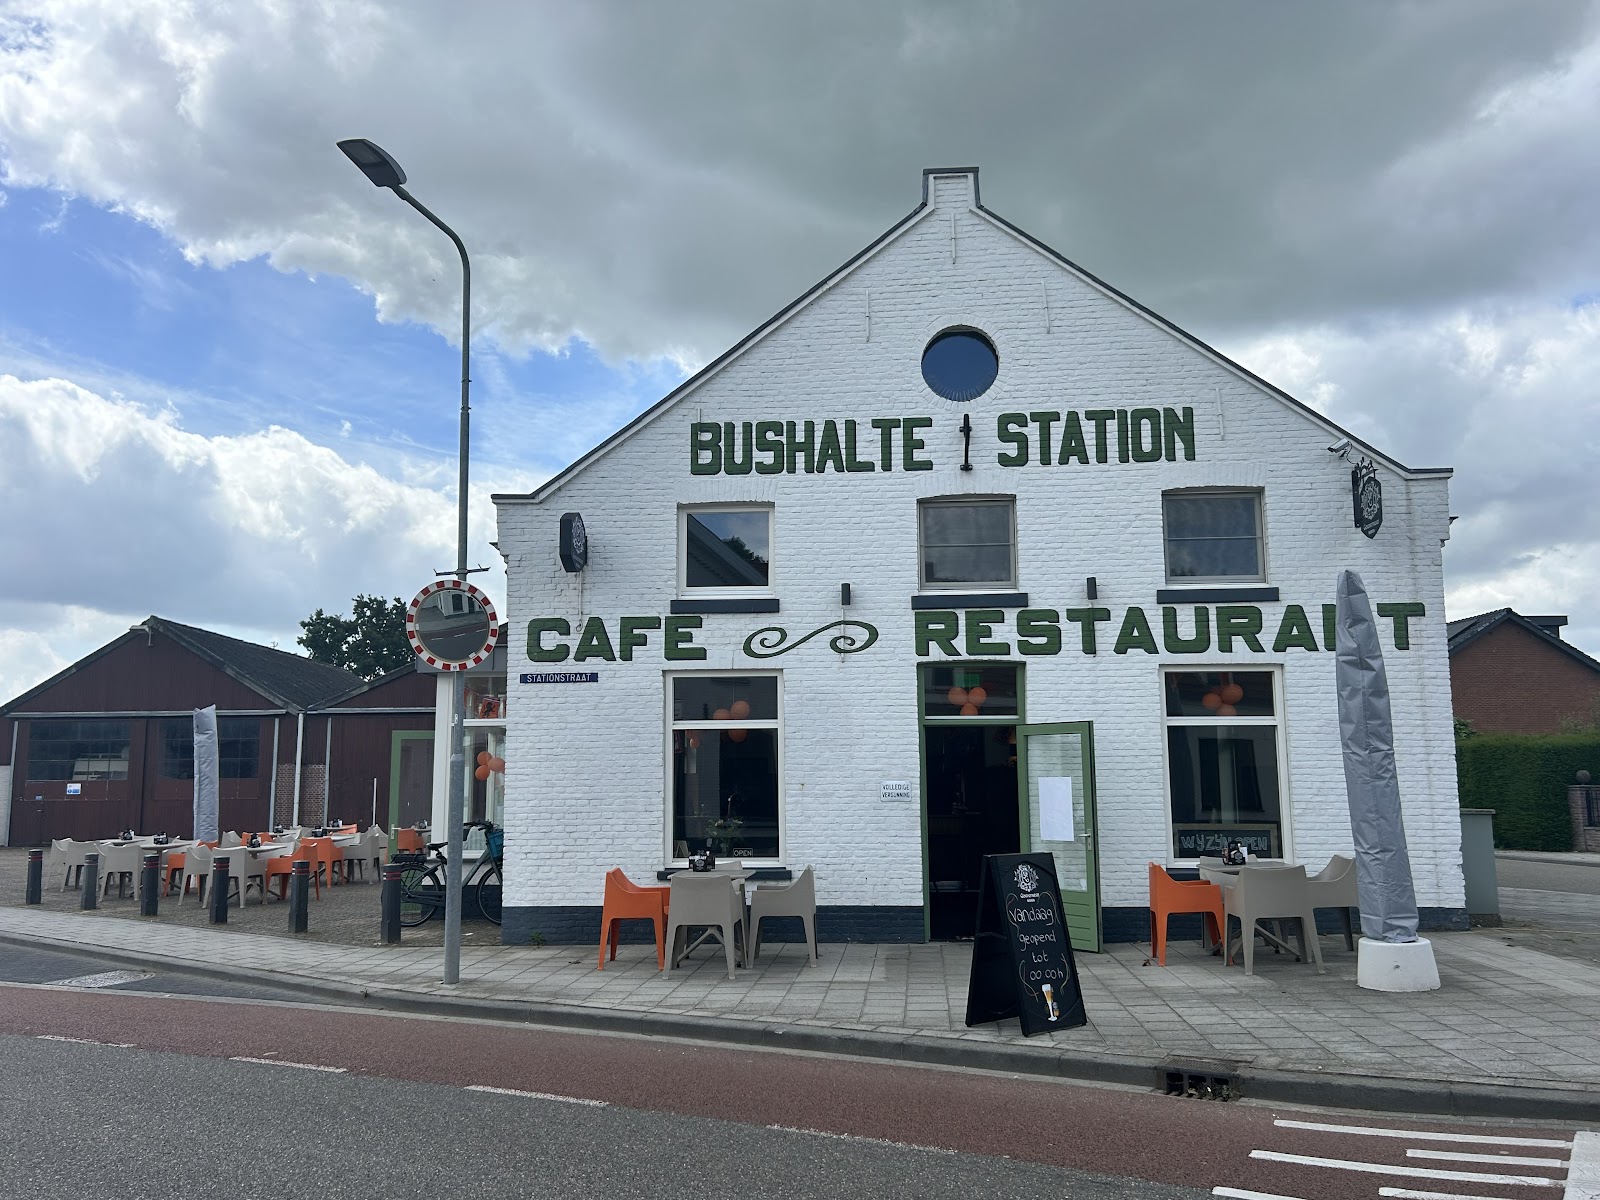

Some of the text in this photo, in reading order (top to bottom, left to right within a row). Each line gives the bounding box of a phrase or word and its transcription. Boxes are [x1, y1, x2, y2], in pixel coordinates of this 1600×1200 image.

[690, 406, 1195, 475] BUSHALTE STATION
[526, 614, 707, 663] CAFE
[526, 673, 592, 683] STATIONSTRAAT
[733, 849, 753, 857] OPEN
[1019, 929, 1057, 952] geopend
[1031, 949, 1049, 963] tot
